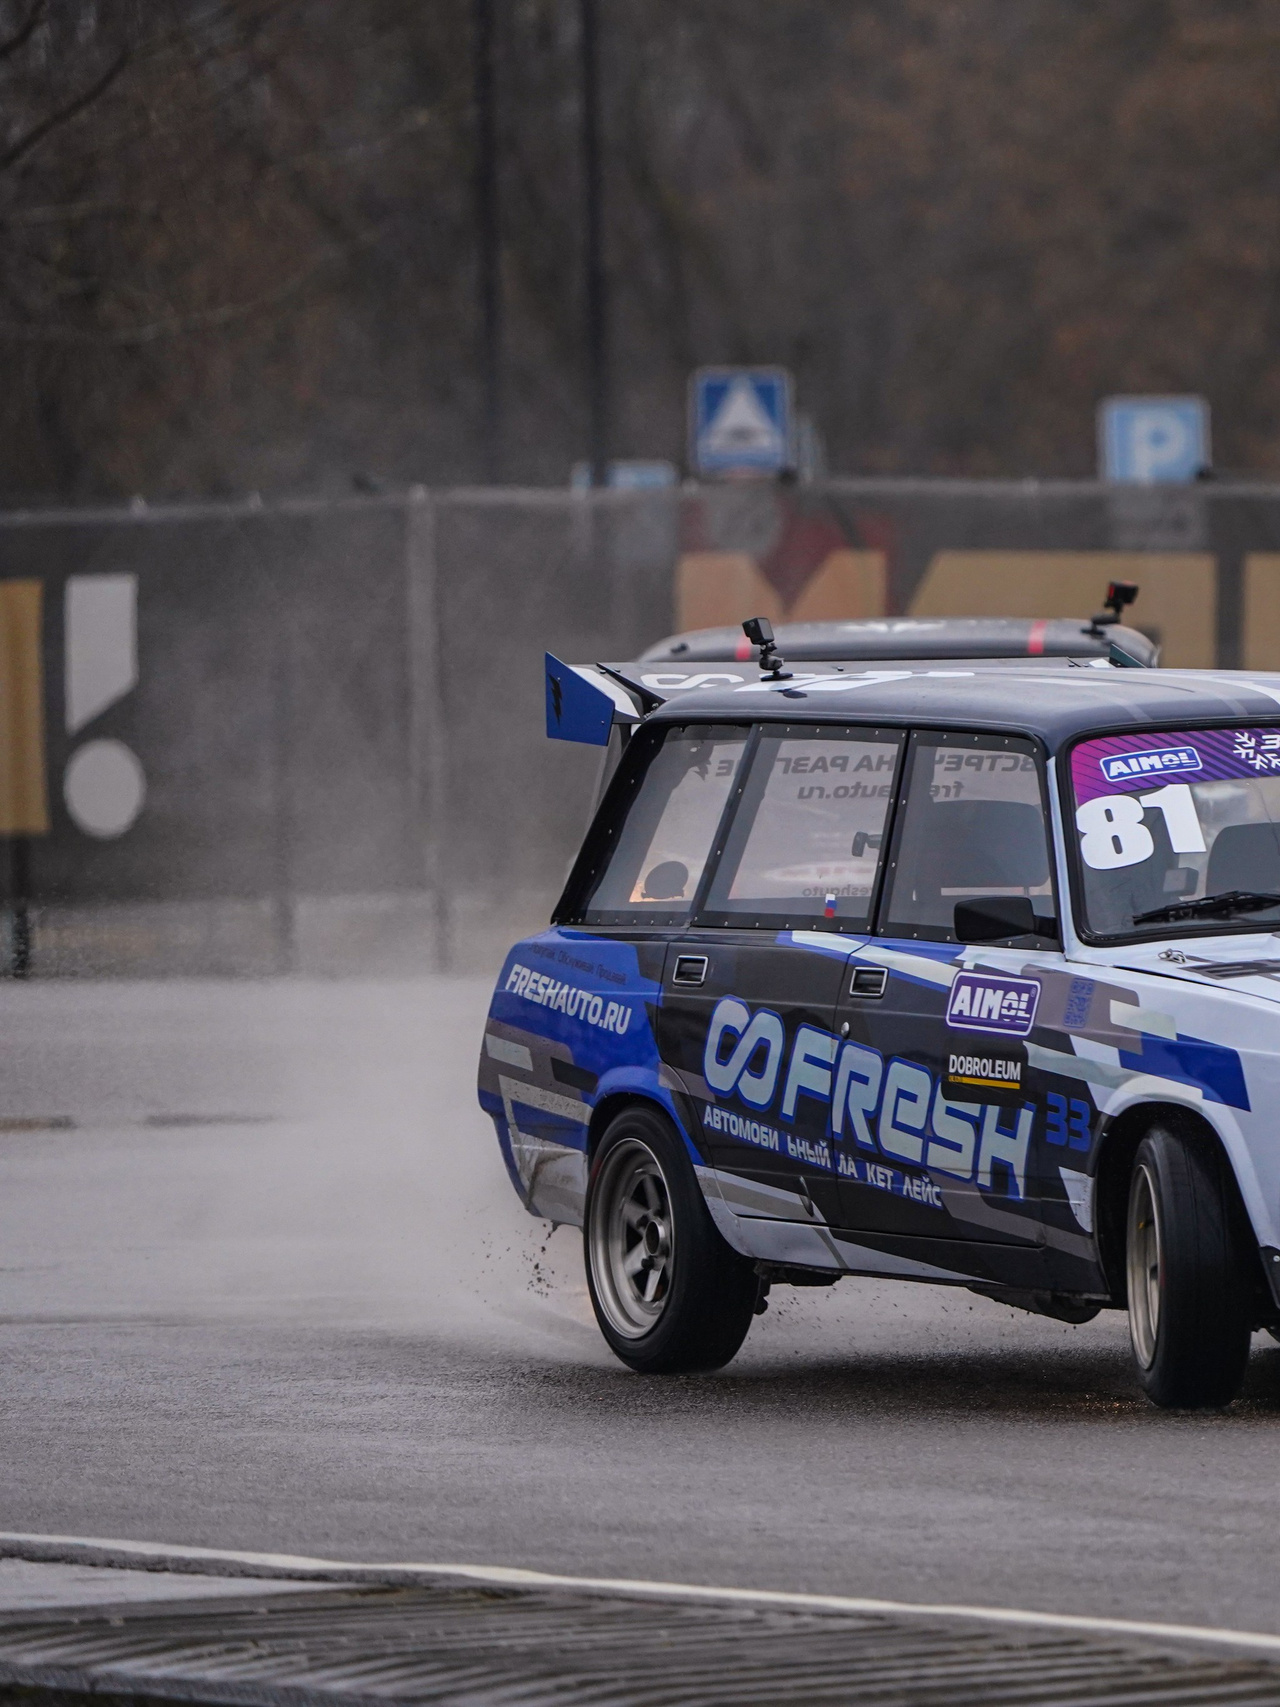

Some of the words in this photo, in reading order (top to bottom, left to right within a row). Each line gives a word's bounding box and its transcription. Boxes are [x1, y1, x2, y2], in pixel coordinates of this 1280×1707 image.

[1108, 749, 1198, 777] AIMOL
[1075, 783, 1207, 870] 81
[505, 963, 632, 1035] FRESHAUTO.RU
[951, 985, 1031, 1024] AIMOL
[948, 1054, 1021, 1081] DOBROLEUM
